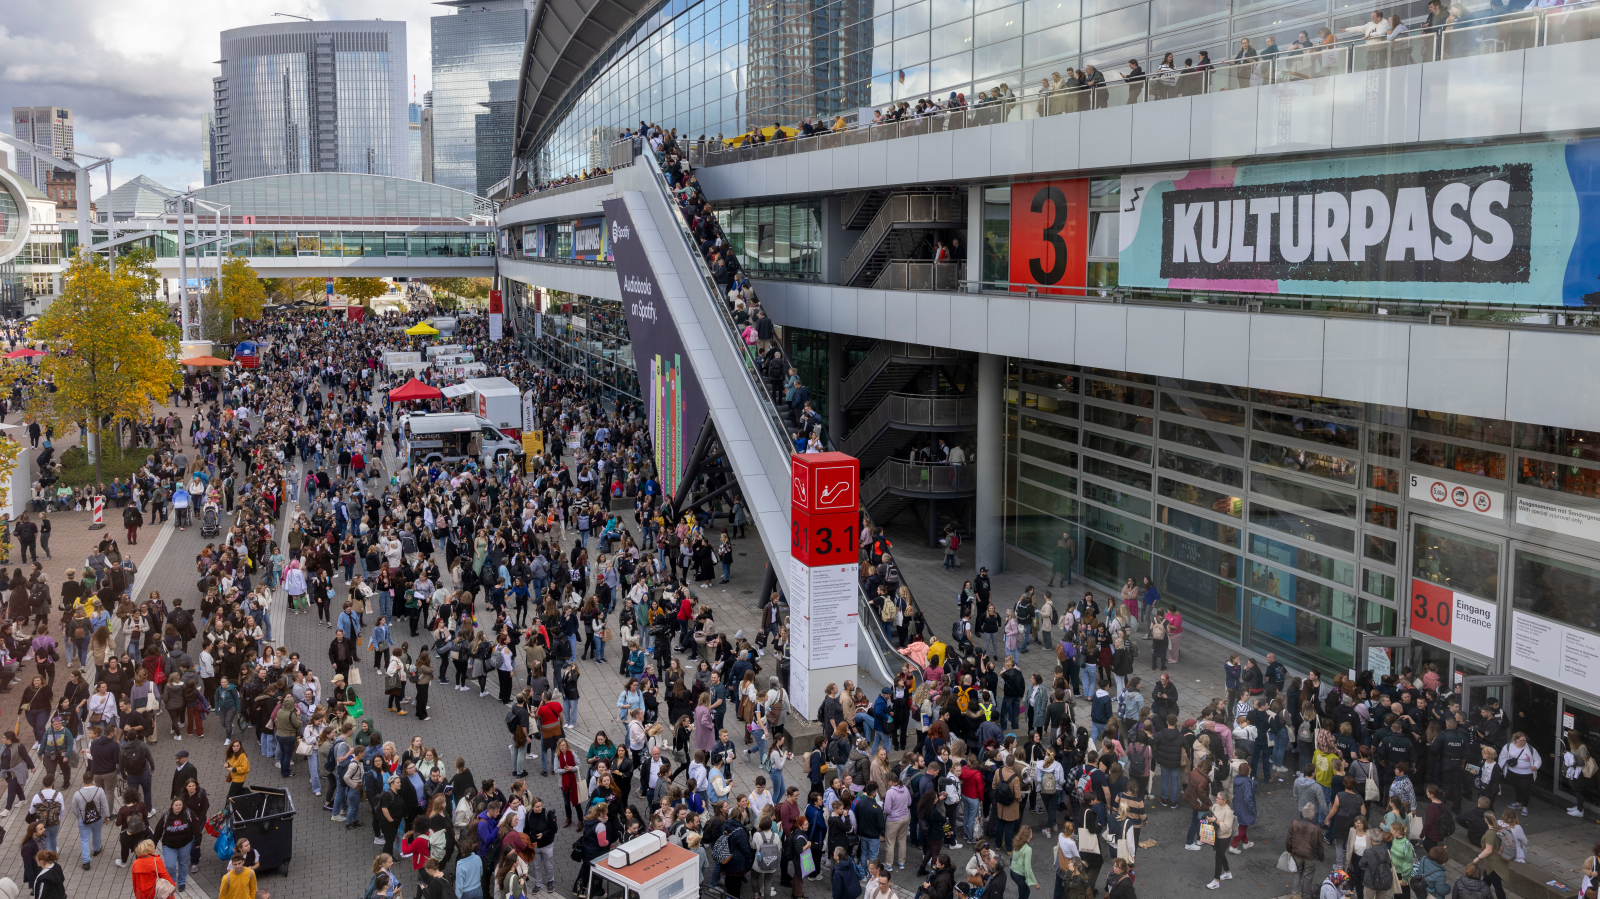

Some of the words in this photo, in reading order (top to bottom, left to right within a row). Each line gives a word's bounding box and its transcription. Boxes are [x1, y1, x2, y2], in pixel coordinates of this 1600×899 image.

[1172, 180, 1514, 264] KULTURPASS
[617, 225, 630, 241] Spotify
[1028, 185, 1068, 286] 3
[624, 274, 652, 296] Audiobooks
[493, 304, 499, 312] 3
[632, 304, 639, 316] on
[1411, 476, 1417, 487] 5
[1519, 500, 1556, 512] Ausgenommen
[1531, 509, 1548, 517] special
[1549, 513, 1570, 521] approval
[792, 520, 809, 554] 3.1
[815, 525, 854, 555] 3.1
[1414, 594, 1450, 627] 3.0
[1456, 600, 1491, 620] Eingang
[1456, 610, 1492, 630] Entrance
